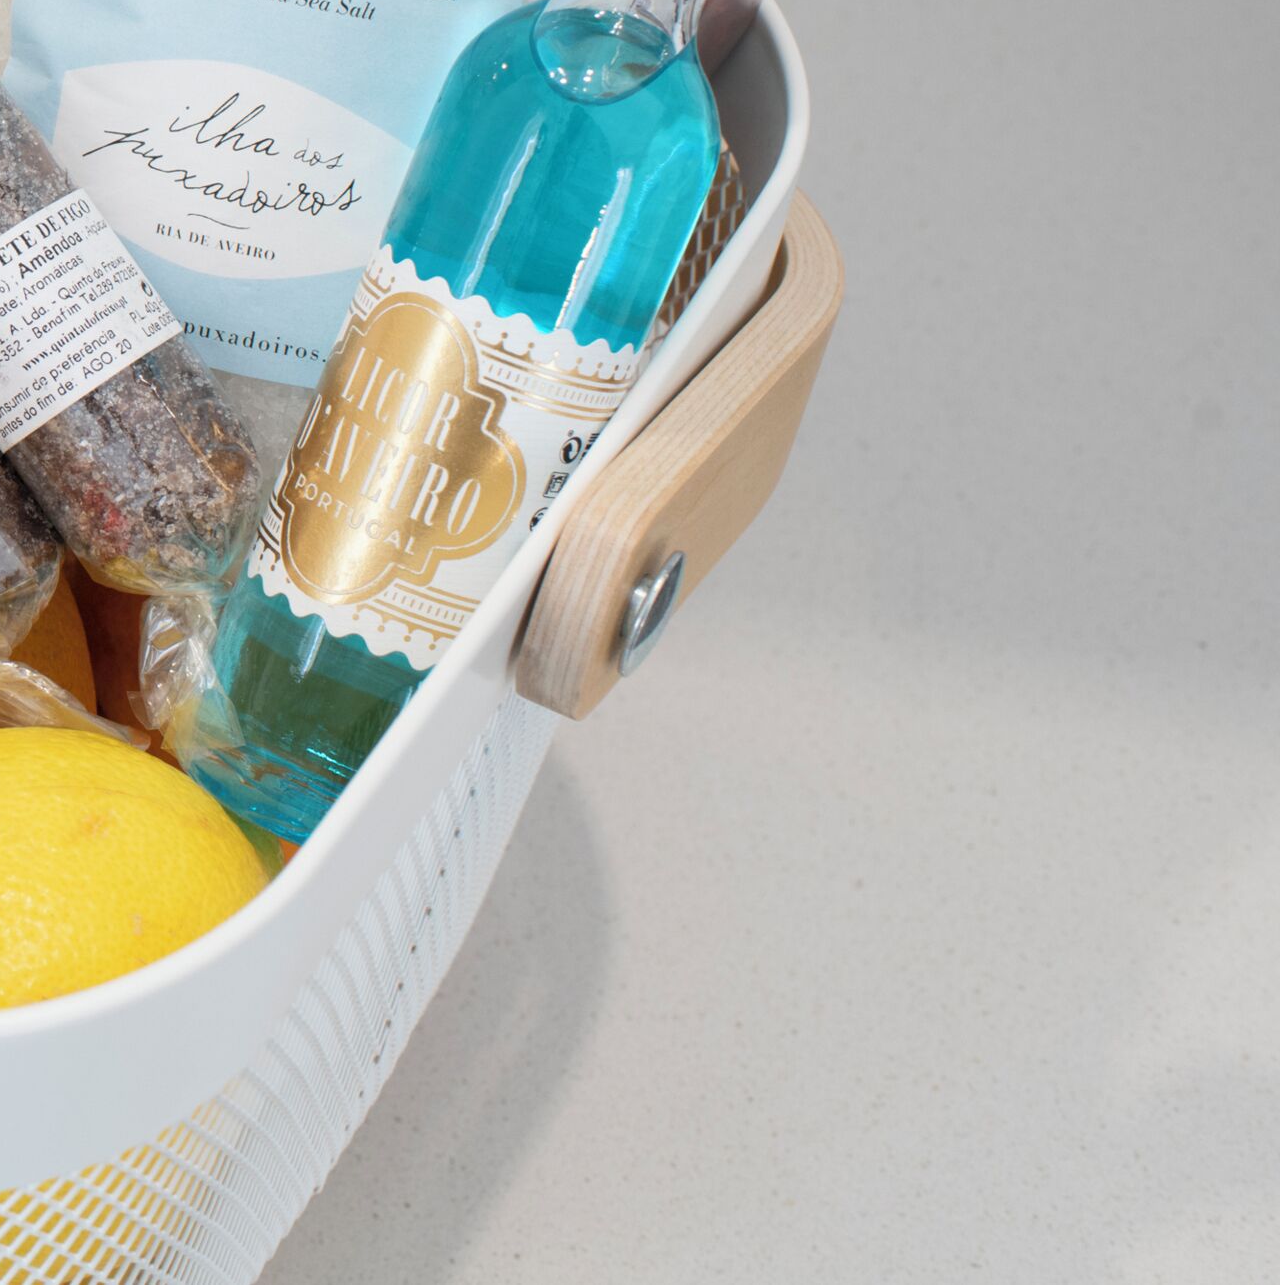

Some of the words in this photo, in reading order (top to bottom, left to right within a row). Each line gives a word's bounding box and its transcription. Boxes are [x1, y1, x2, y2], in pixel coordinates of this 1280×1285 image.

[168, 92, 281, 157] ilha
[293, 138, 346, 171] dos
[82, 127, 363, 215] puxadoiros
[34, 215, 61, 239] DE
[57, 198, 90, 225] FIGO
[155, 222, 183, 243] RIA
[188, 231, 211, 248] DE
[215, 237, 277, 262] AVEIRO
[17, 231, 83, 279] Amêndoa
[22, 254, 83, 300] Aromáticas
[31, 302, 81, 339] Benafim
[141, 321, 161, 337] Lote
[0, 416, 23, 438] antes
[22, 406, 37, 420] do
[35, 393, 56, 410] fim
[115, 338, 132, 355] 20
[31, 376, 48, 391] de
[48, 329, 120, 382] preferência
[340, 346, 461, 454] LICOR
[296, 393, 482, 537] D'AVEIRO
[294, 472, 417, 557] PORTUGAL
